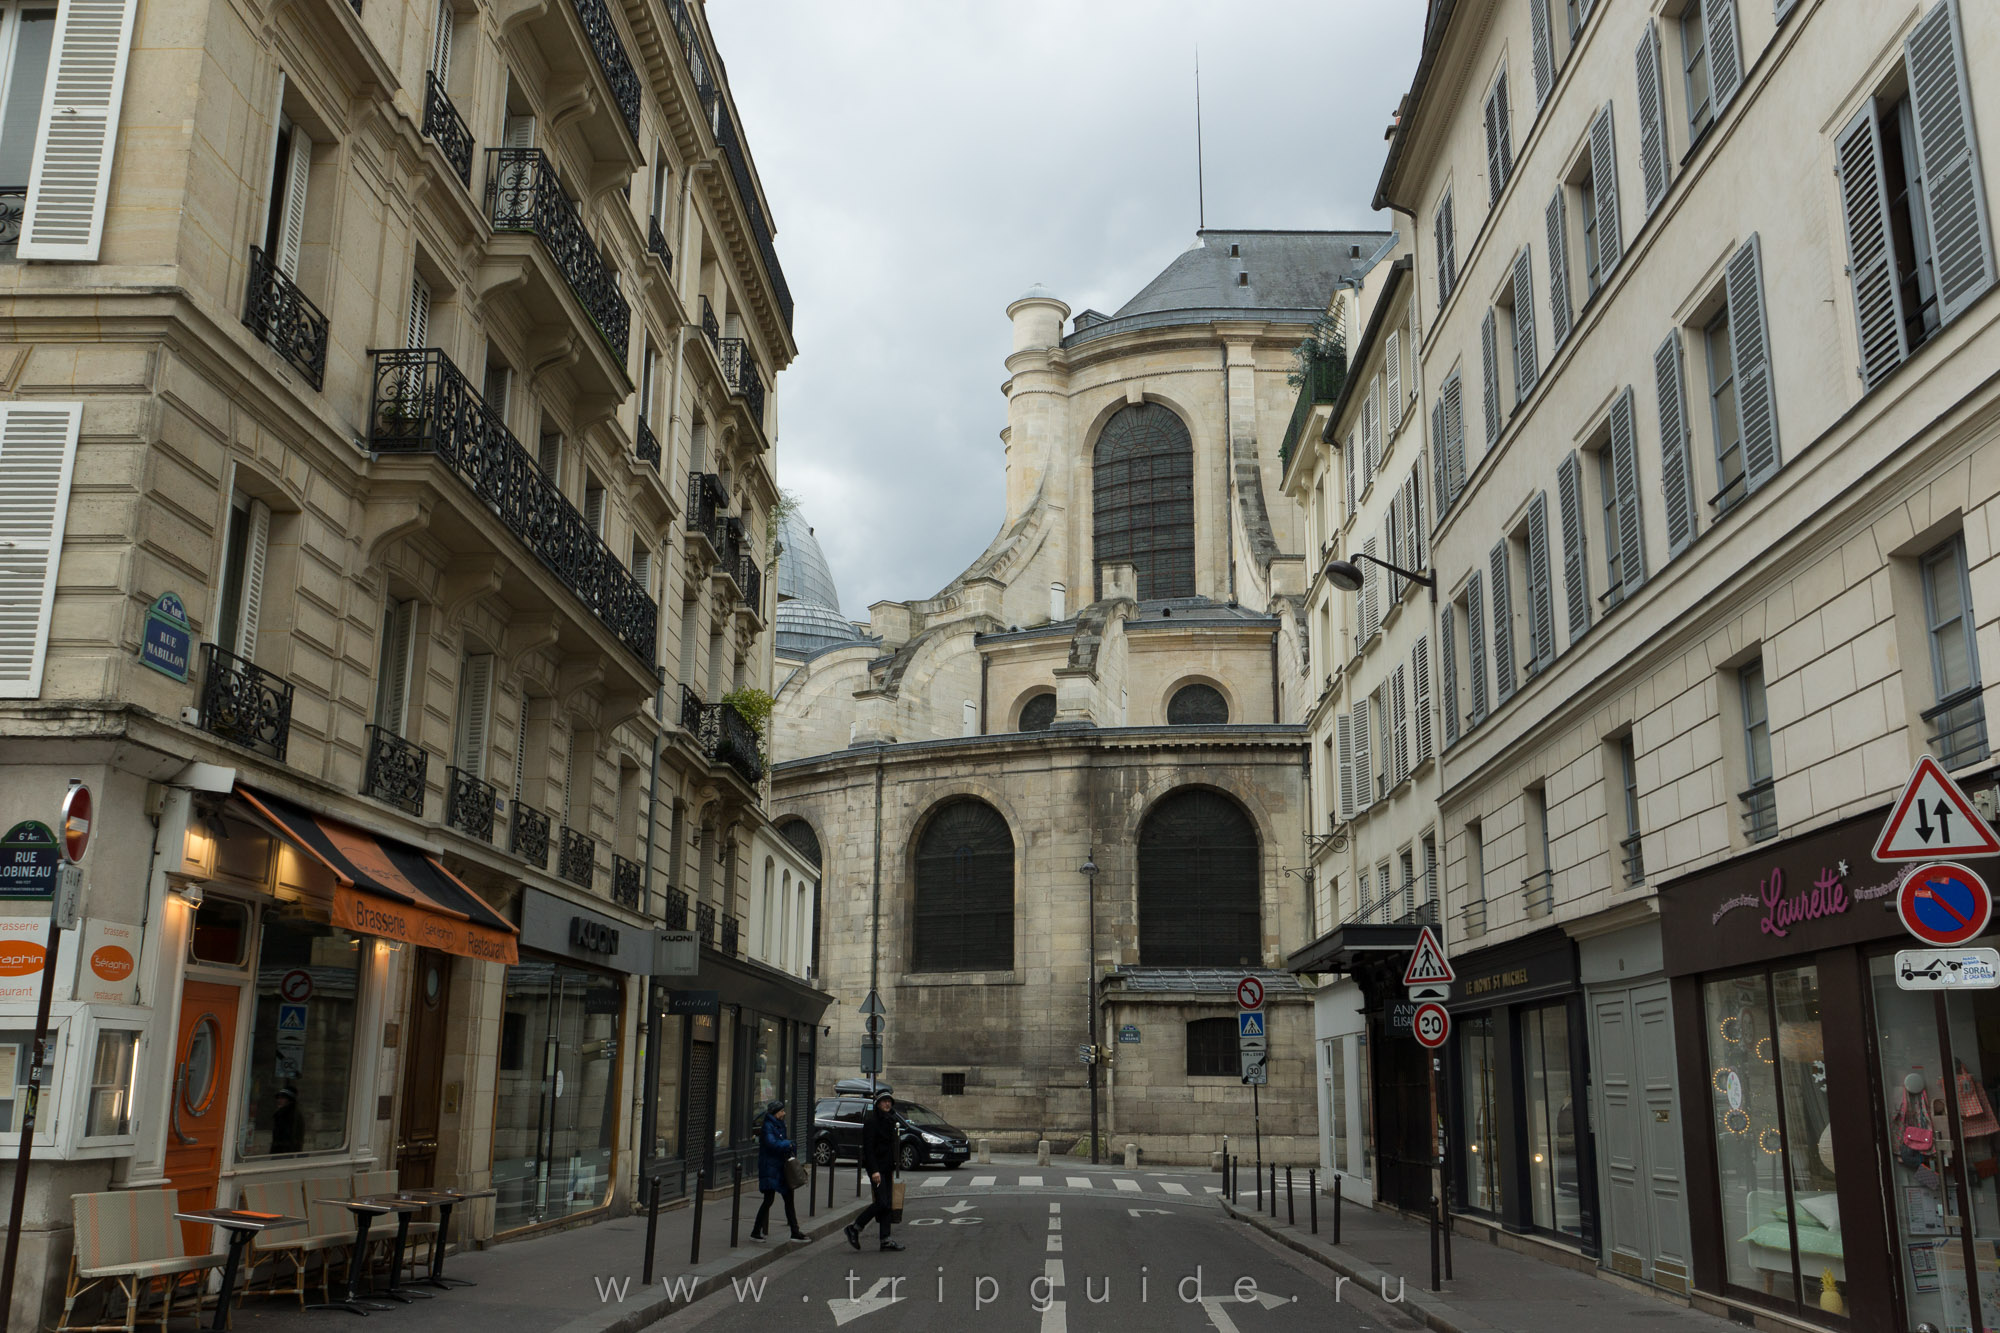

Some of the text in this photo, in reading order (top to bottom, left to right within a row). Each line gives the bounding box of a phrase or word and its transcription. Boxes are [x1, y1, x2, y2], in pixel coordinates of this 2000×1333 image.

[160, 632, 177, 648] RUE
[147, 642, 184, 668] MABILLON
[15, 851, 37, 863] RUE
[66, 869, 81, 888] SAUF
[1761, 866, 1848, 937] Laurette
[104, 927, 129, 938] brasserie
[356, 900, 406, 937] Brasserie
[467, 931, 506, 960] Restaurant
[1963, 966, 1991, 975] SORAL
[1465, 967, 1528, 996] LE MONT ST MICHEL
[94, 991, 123, 1001] restaurant
[1421, 1016, 1442, 1035] 30
[1249, 1067, 1259, 1075] 30
